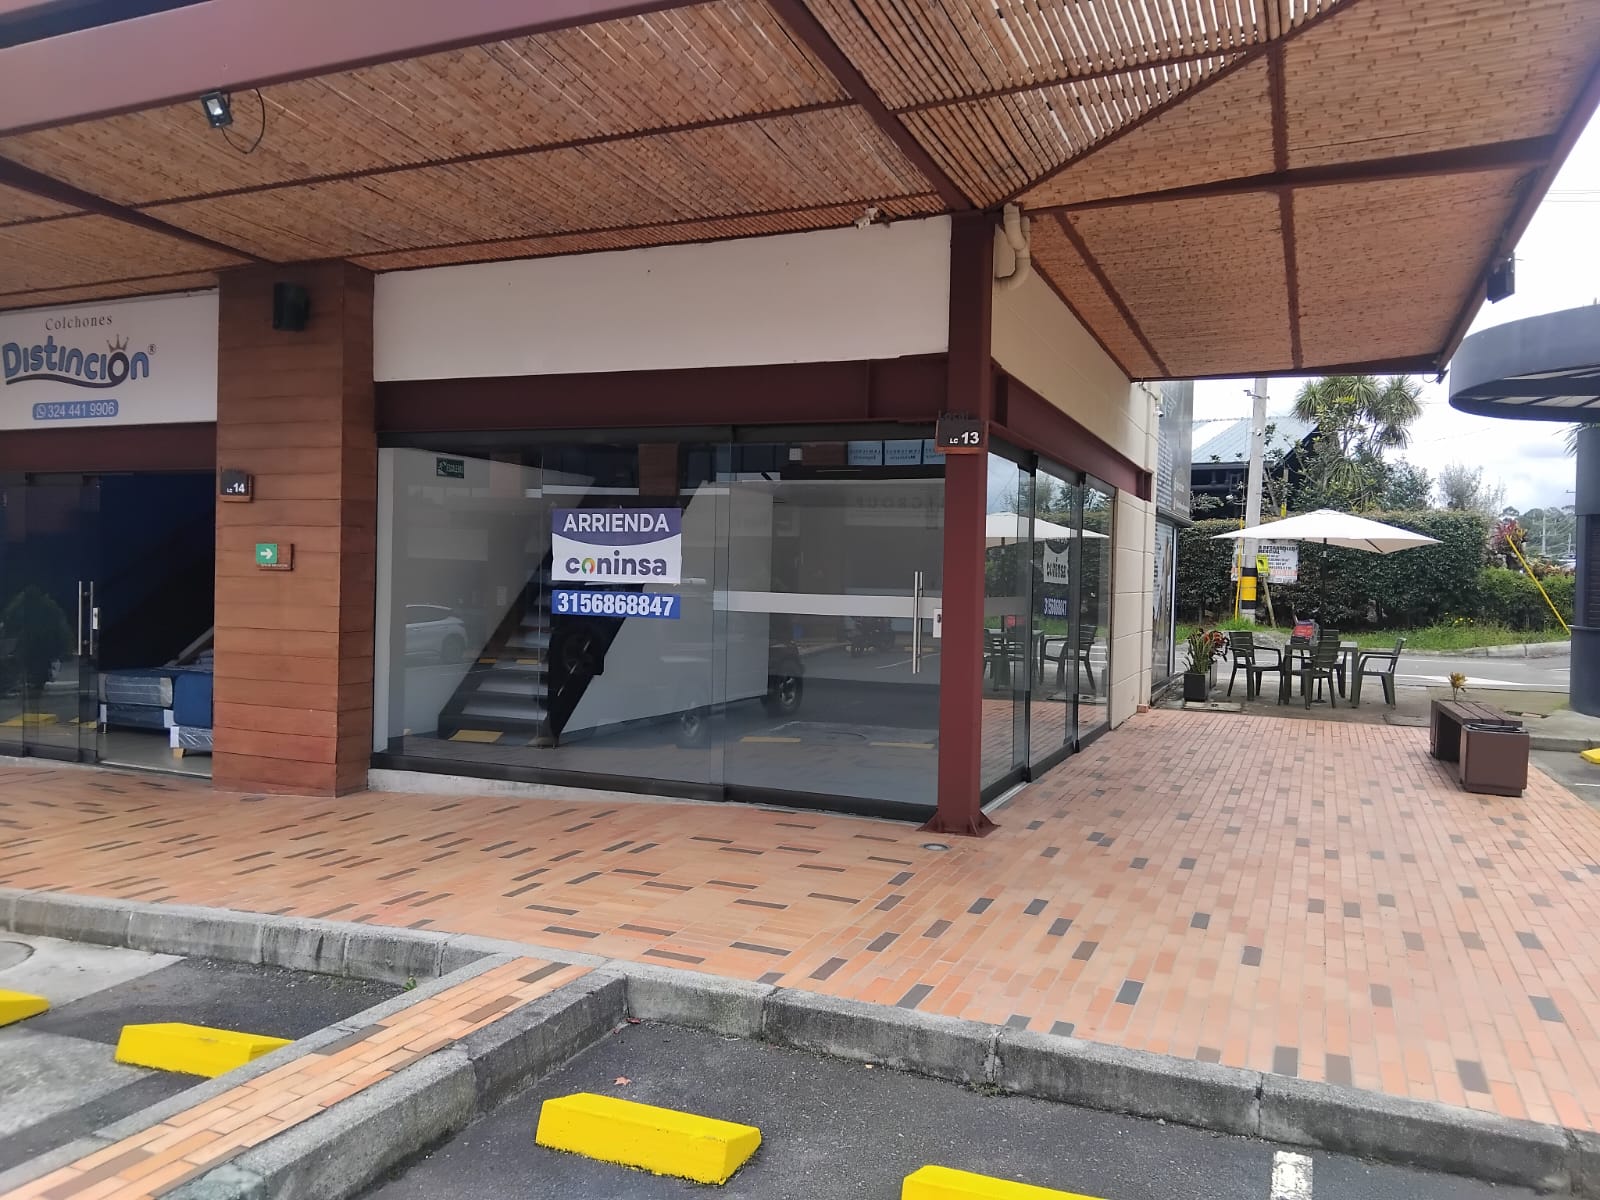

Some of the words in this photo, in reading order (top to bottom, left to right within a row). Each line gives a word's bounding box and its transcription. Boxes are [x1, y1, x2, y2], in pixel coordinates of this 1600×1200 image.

[45, 315, 113, 330] Colchones
[47, 404, 65, 418] 324
[68, 404, 86, 417] 441
[90, 402, 115, 416] 9906
[961, 431, 980, 444] 13
[234, 483, 245, 493] 14
[563, 513, 670, 532] ARRIENDA
[565, 550, 667, 576] coninsa
[558, 592, 674, 616] 3156868847
